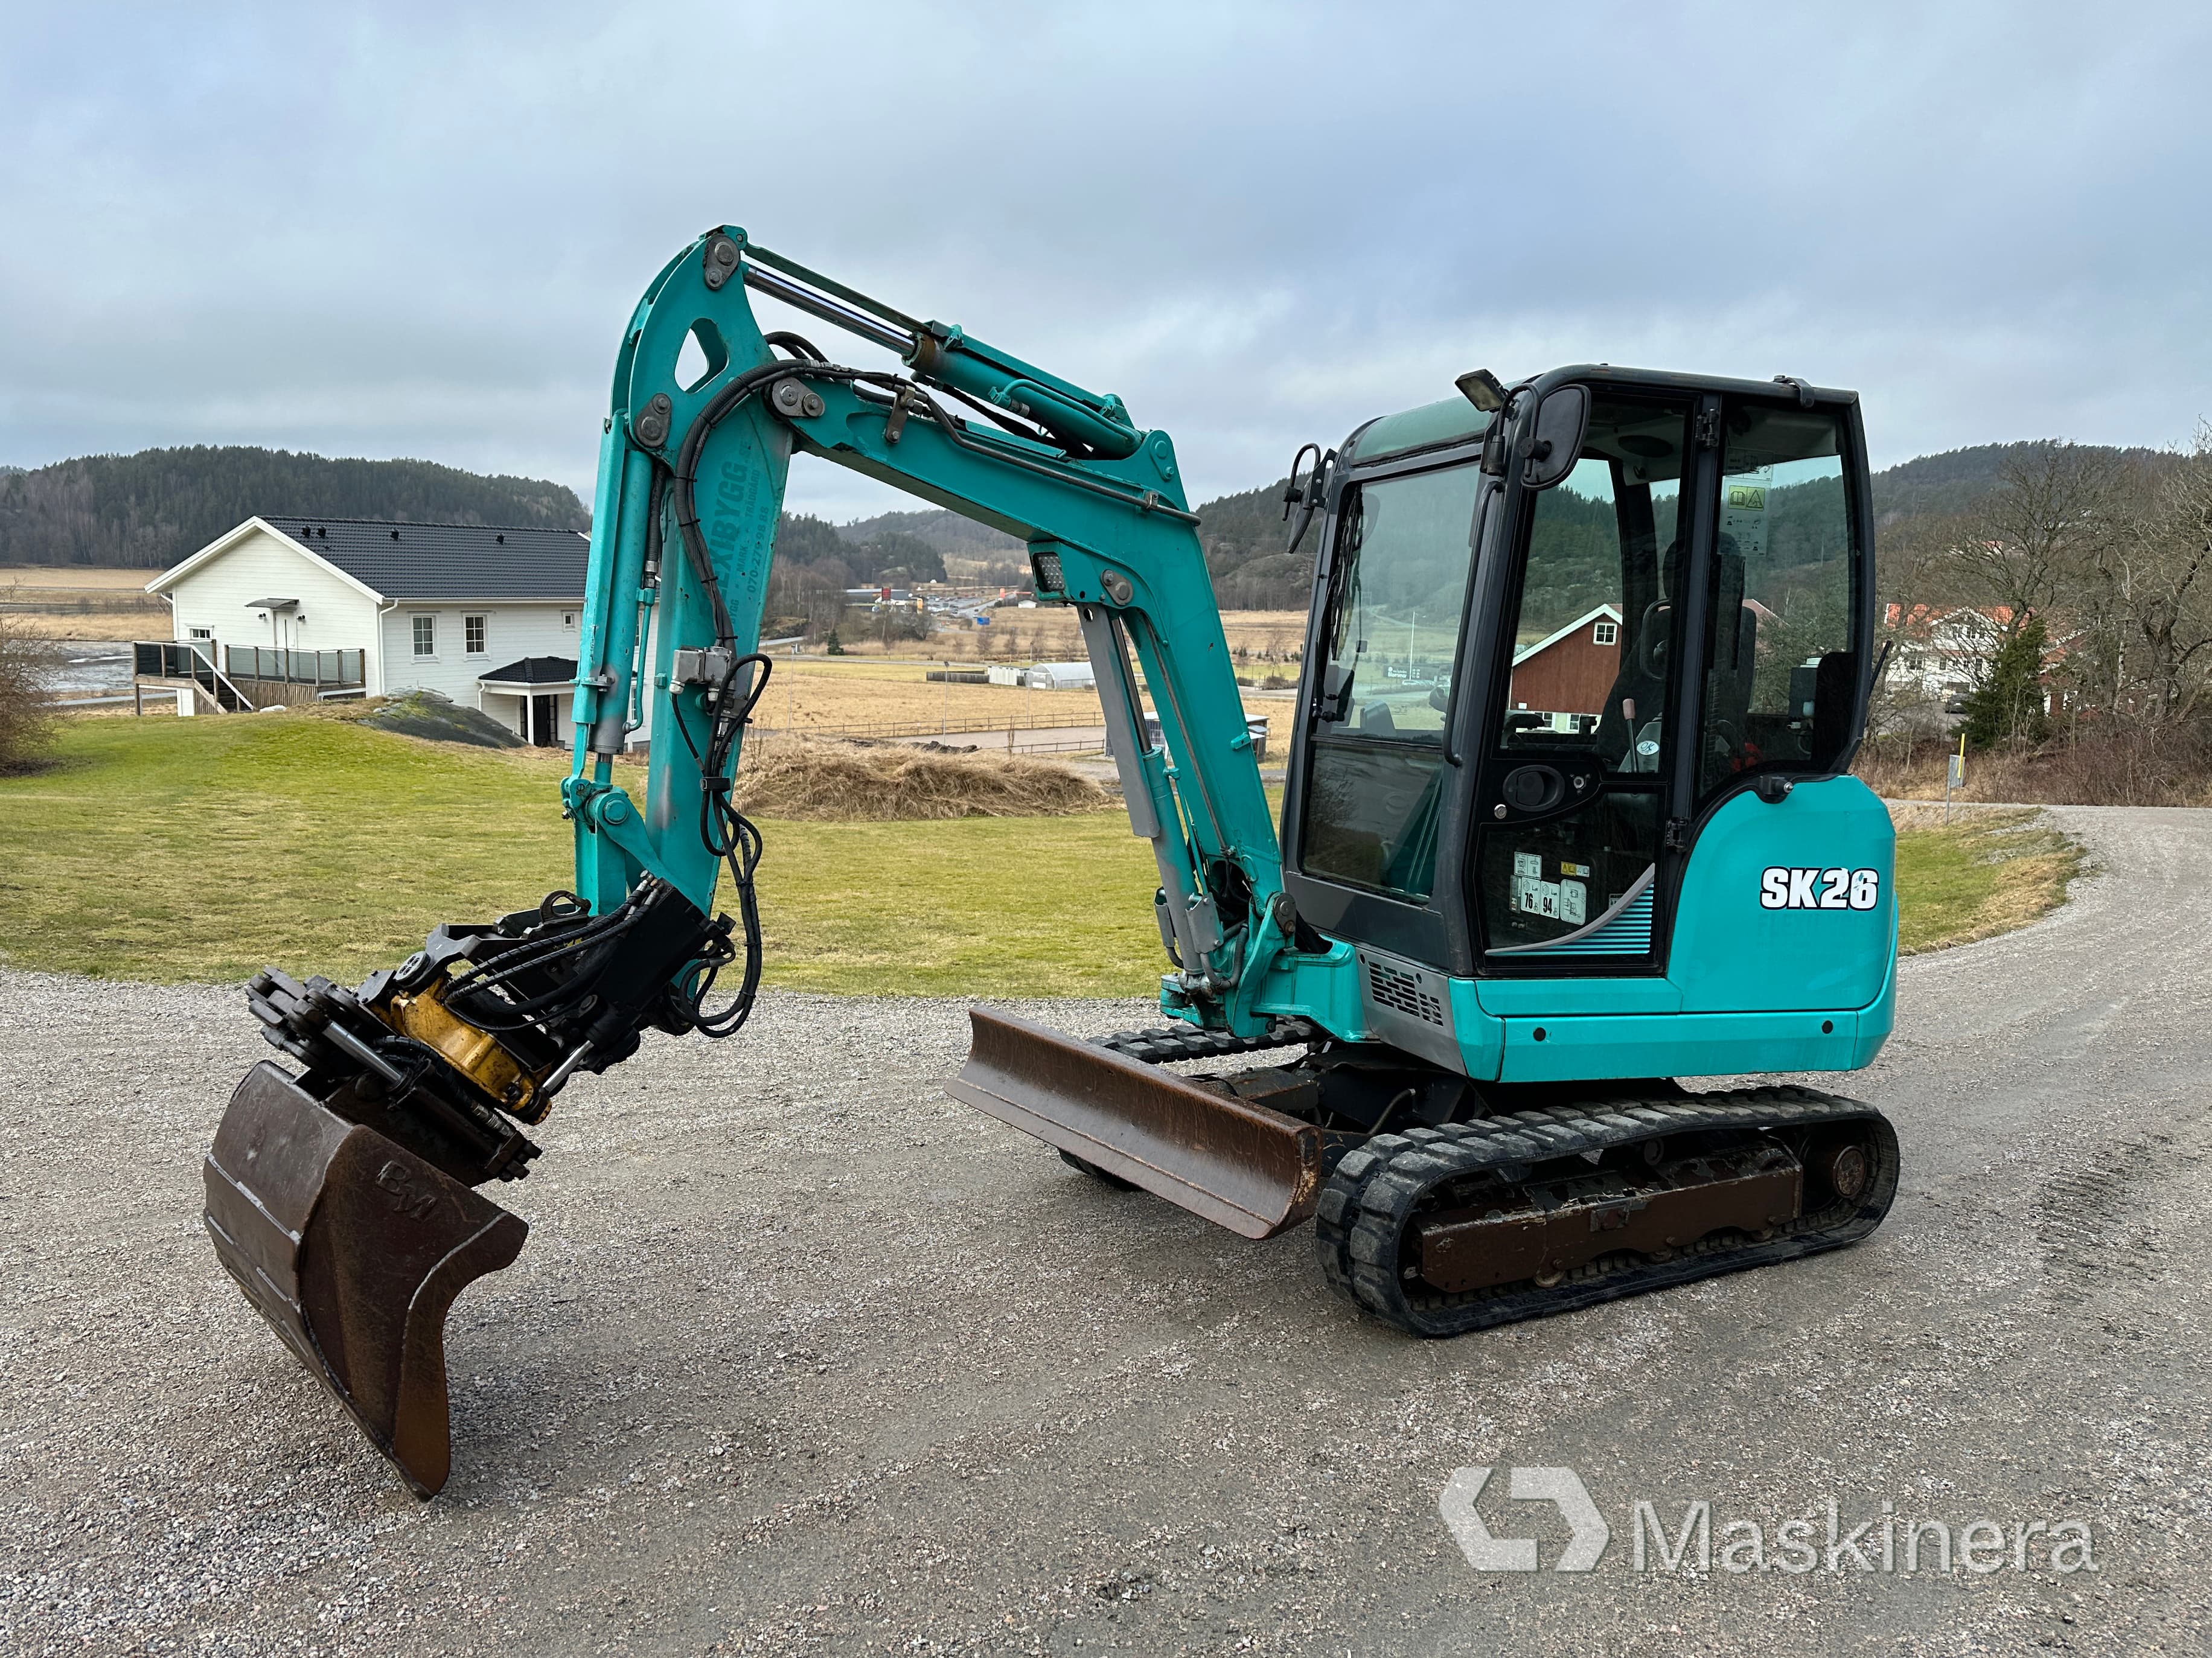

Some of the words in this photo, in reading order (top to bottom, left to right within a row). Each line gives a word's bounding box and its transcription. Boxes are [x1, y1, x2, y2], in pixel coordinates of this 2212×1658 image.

[737, 545, 748, 572] MARK
[1760, 866, 1879, 911] SK26
[1524, 892, 1533, 909] 76
[1542, 896, 1552, 914] 94
